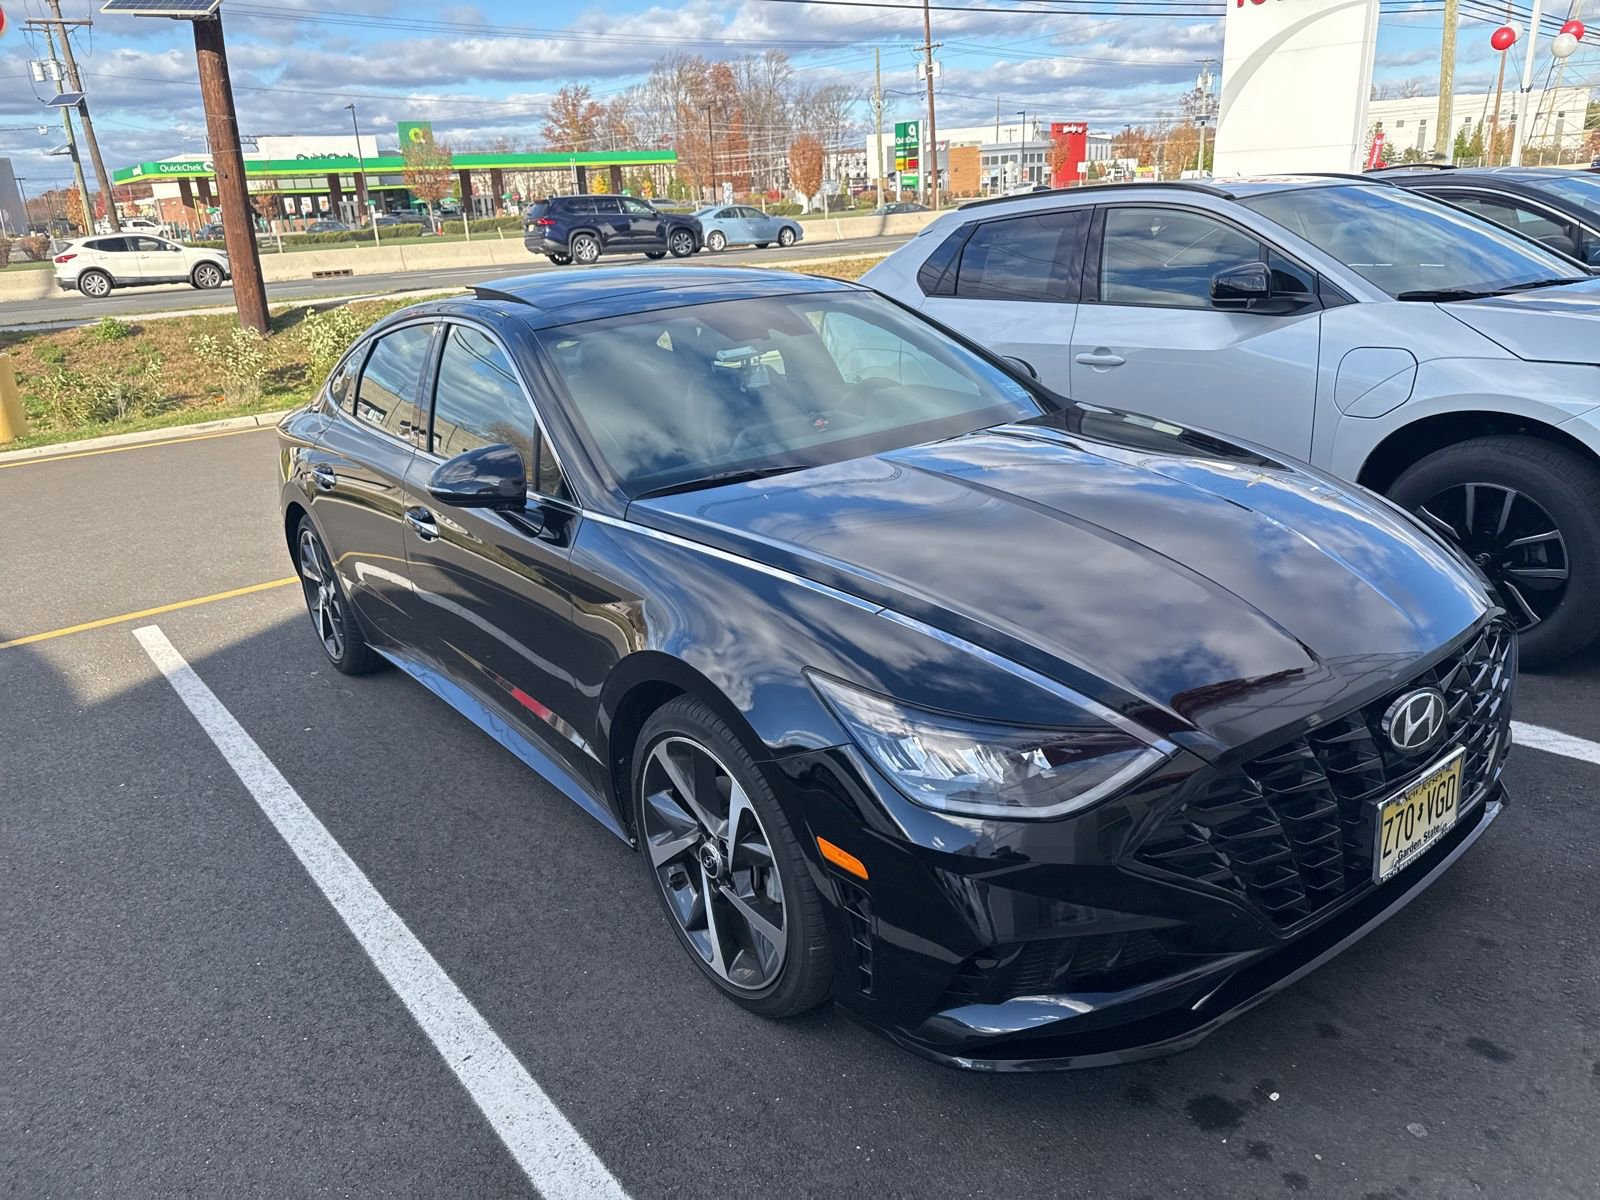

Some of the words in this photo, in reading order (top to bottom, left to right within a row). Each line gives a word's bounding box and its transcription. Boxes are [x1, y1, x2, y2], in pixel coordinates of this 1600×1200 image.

[160, 164, 202, 172] QuickChek
[1419, 773, 1442, 796] Jersey
[1383, 803, 1414, 859] Z70
[1427, 774, 1456, 825] VGD
[1397, 838, 1422, 860] Garden
[1423, 823, 1440, 842] State
